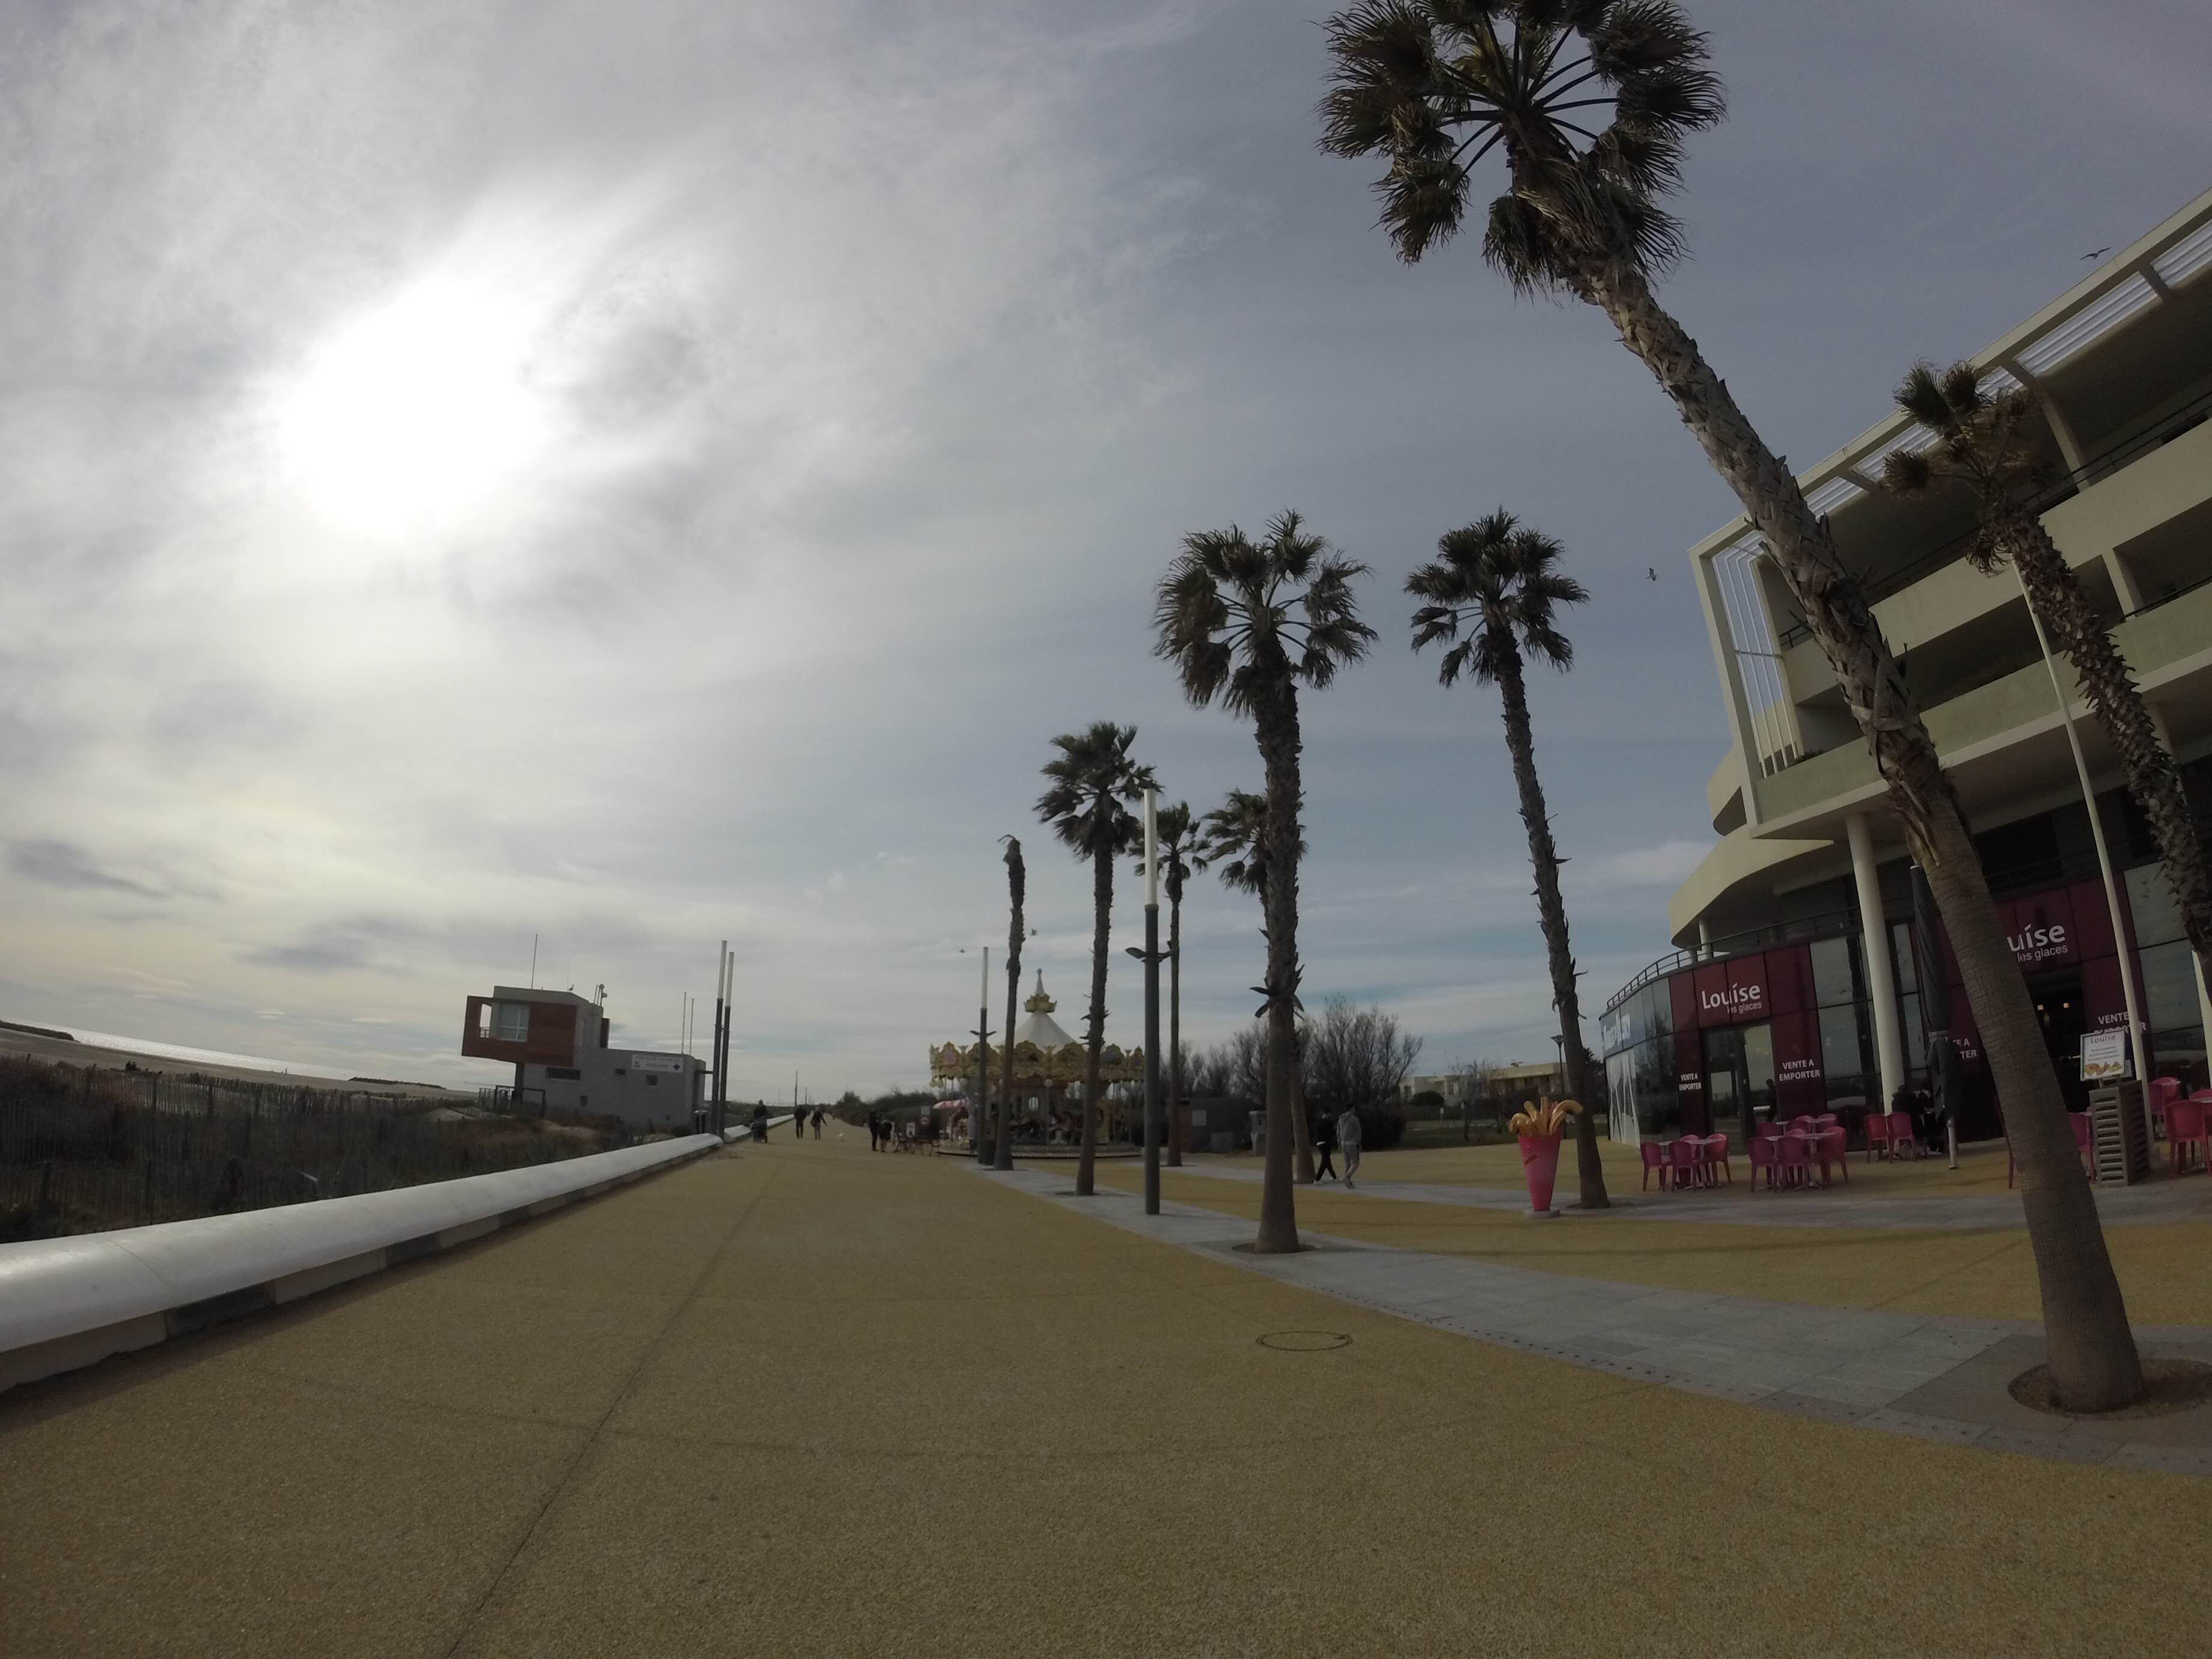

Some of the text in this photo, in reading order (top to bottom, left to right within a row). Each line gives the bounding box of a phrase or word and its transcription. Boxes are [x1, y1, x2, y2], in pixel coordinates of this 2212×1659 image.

[2017, 945, 2068, 962] les glaces
[1738, 1001, 1762, 1014] glaces
[2098, 1012, 2129, 1025] VENTE
[1782, 1059, 1814, 1069] VENTE A
[1680, 1073, 1694, 1081] VENTE
[1779, 1069, 1821, 1081] EMPORTER
